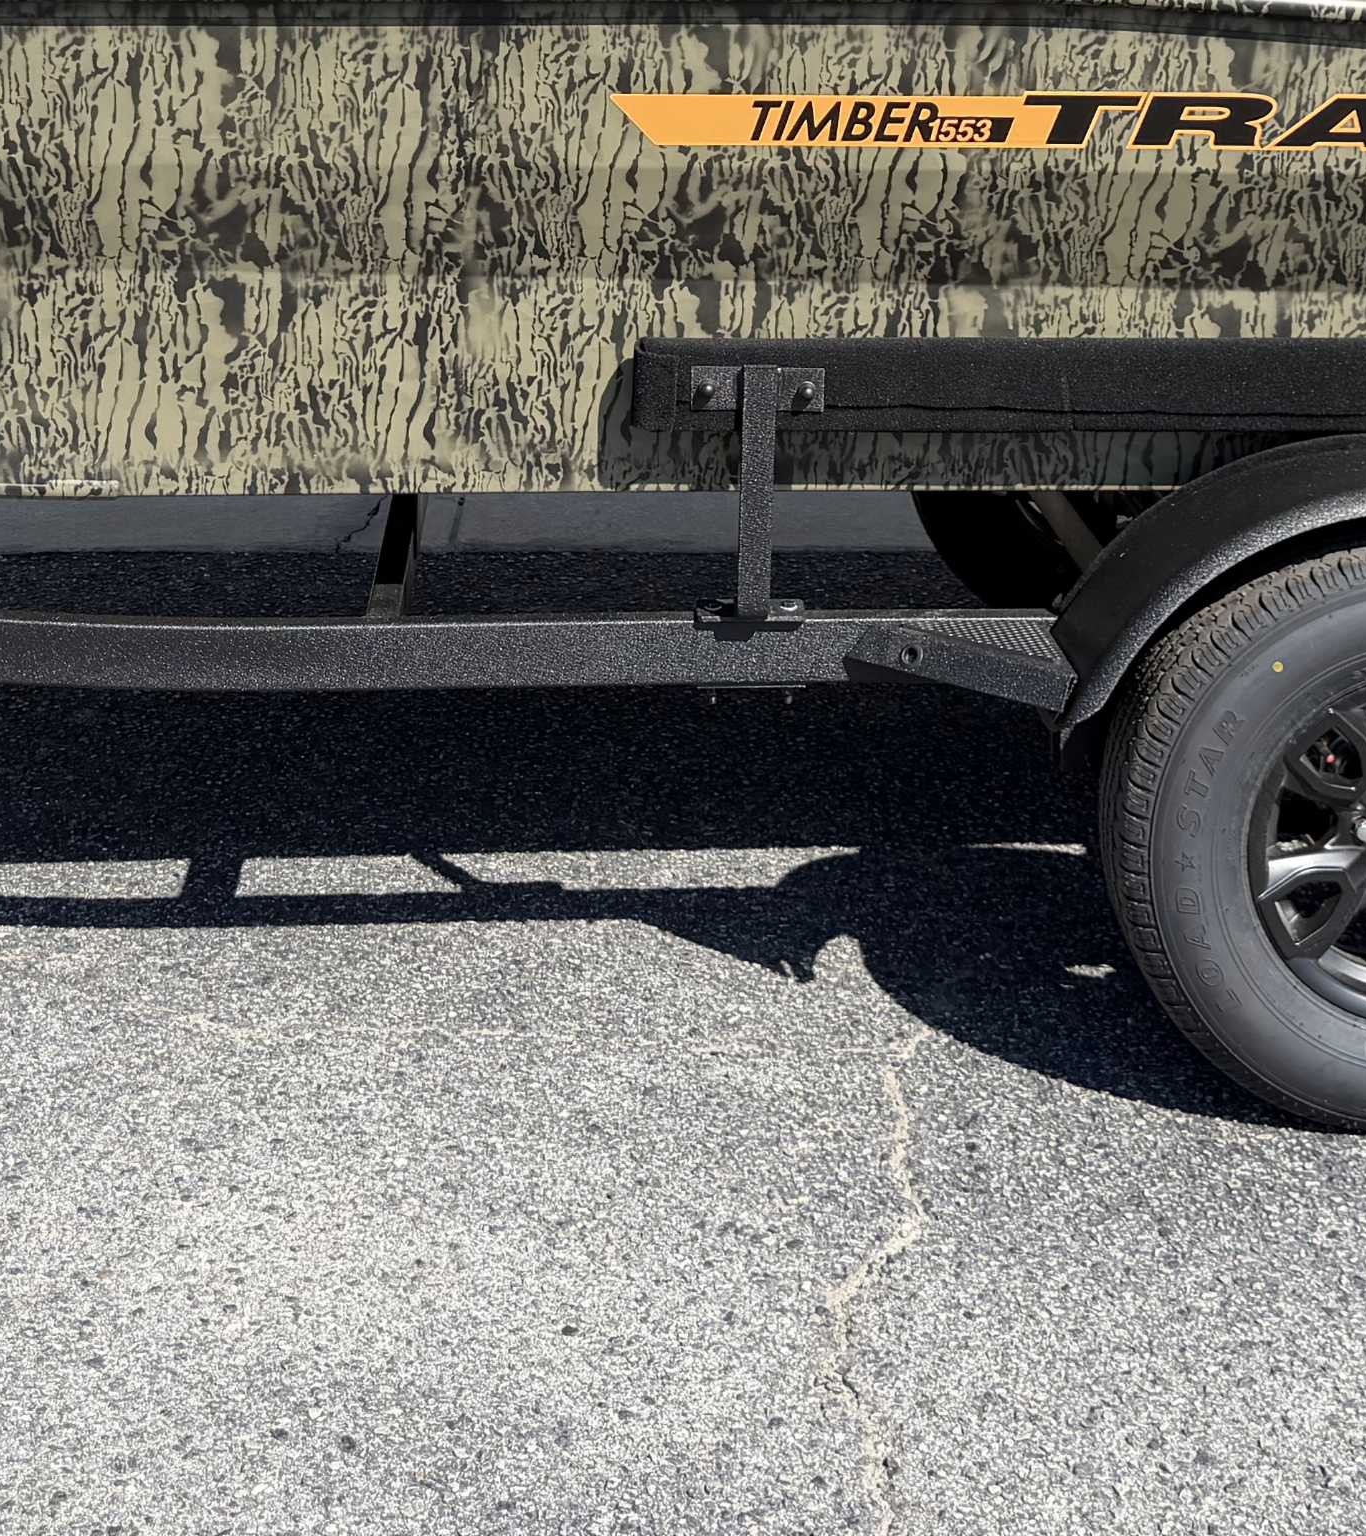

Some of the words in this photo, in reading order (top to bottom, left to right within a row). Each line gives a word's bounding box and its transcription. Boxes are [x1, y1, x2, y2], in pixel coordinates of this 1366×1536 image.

[750, 100, 941, 143] TIMBER
[928, 117, 992, 143] 1553
[1176, 710, 1245, 838] STAR
[1176, 886, 1243, 1014] LOAD
